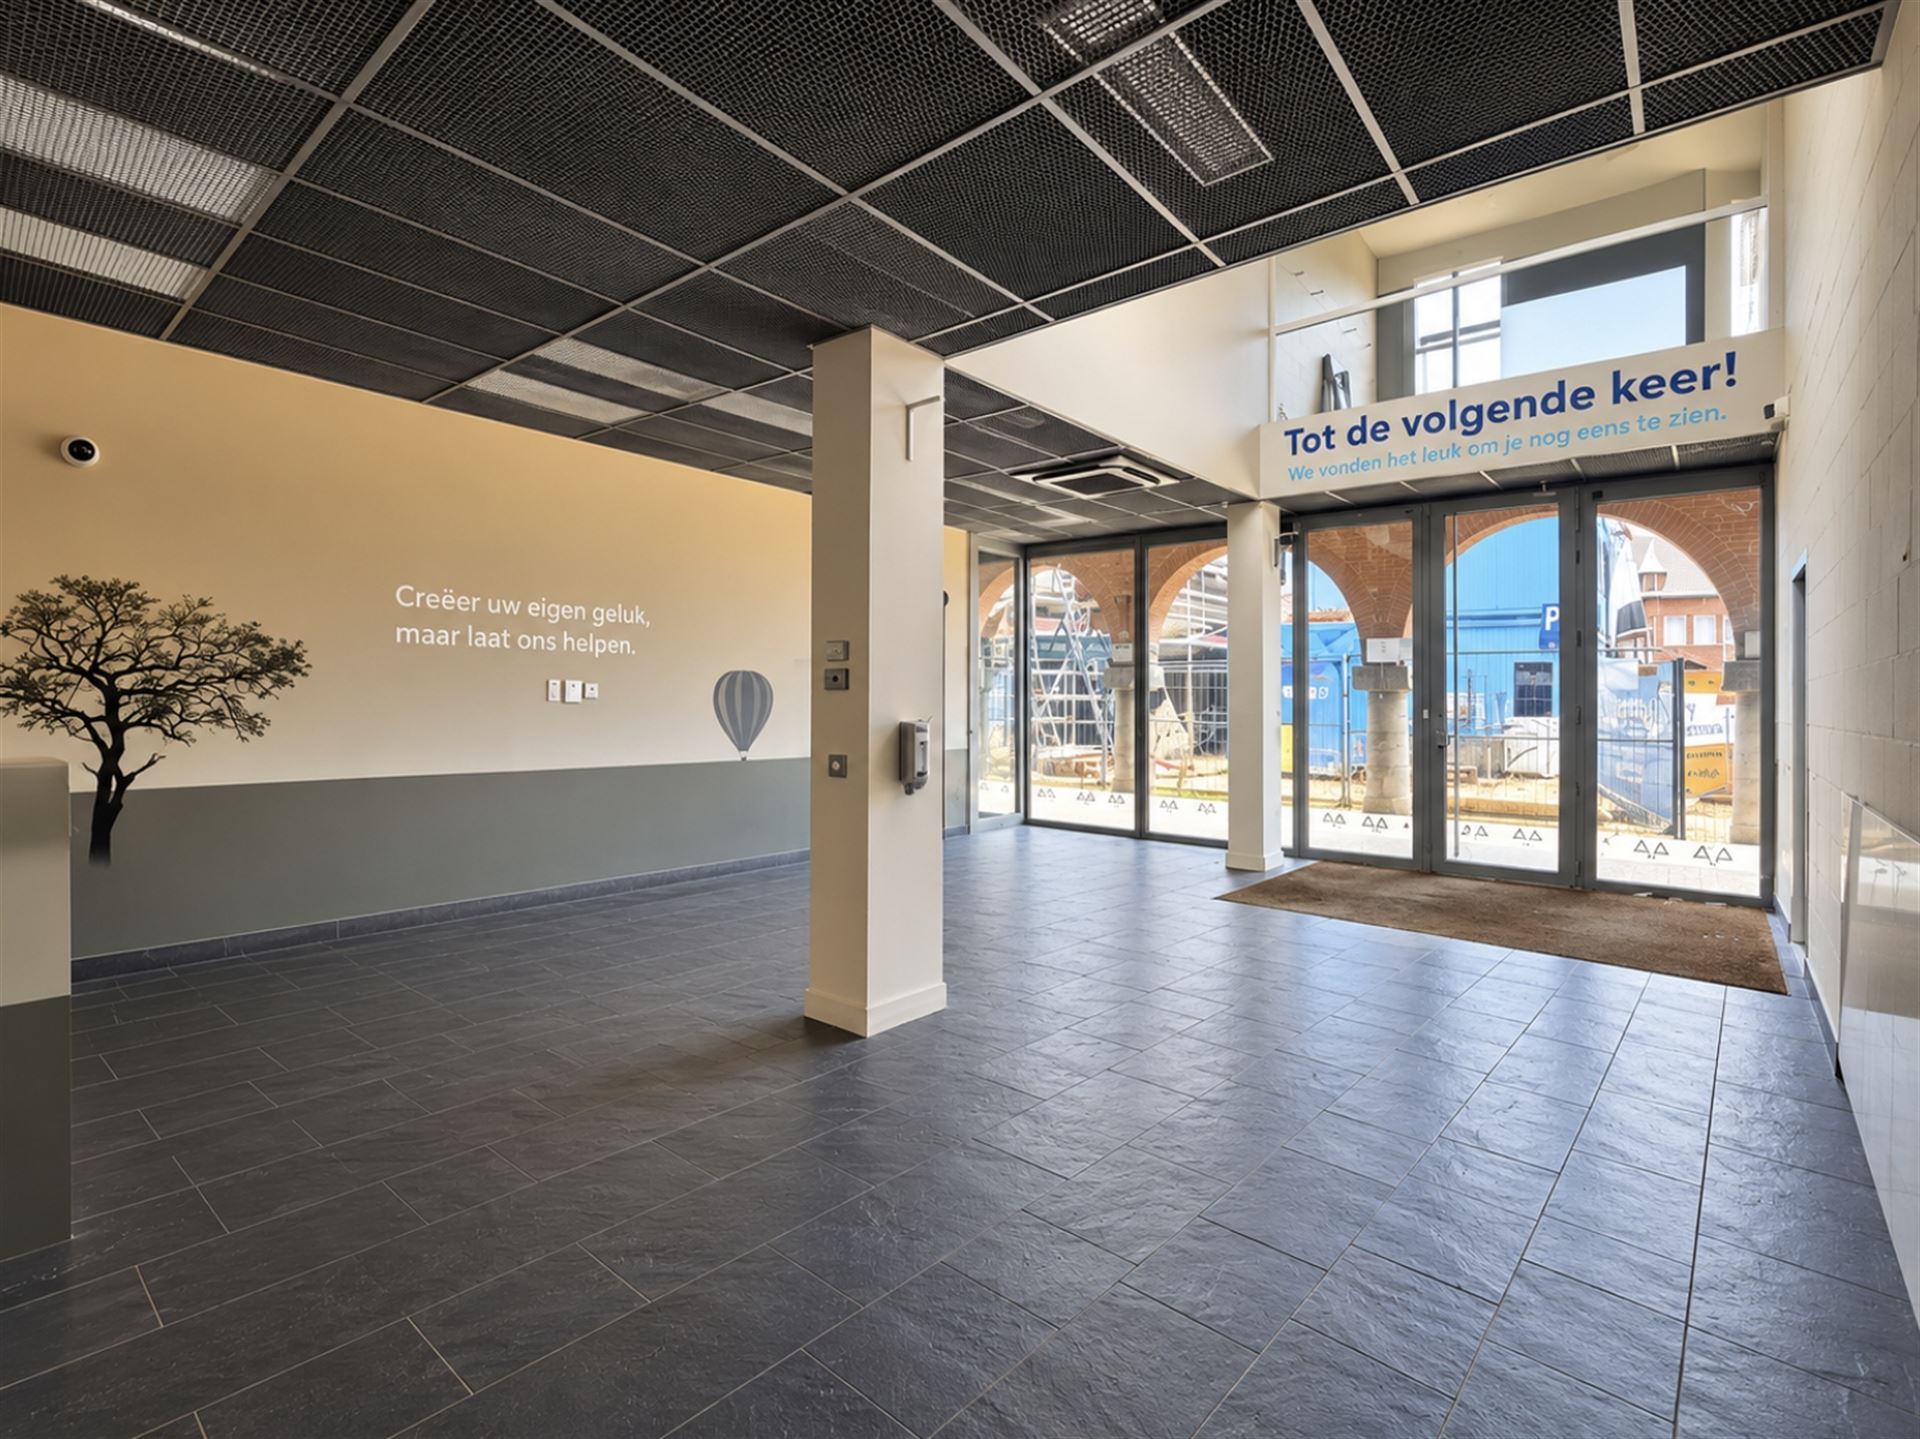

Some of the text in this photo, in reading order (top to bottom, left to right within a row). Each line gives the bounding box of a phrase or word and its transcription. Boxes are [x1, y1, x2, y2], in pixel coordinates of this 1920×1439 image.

[1284, 351, 1737, 456] Tot de volgende keer!
[1288, 406, 1727, 481] We vonden het leuk om je nog eens te zien.
[395, 584, 651, 628] Creëer uw eigen geluk,
[1545, 606, 1560, 631] P
[395, 624, 636, 657] maar laat ons helpen.
